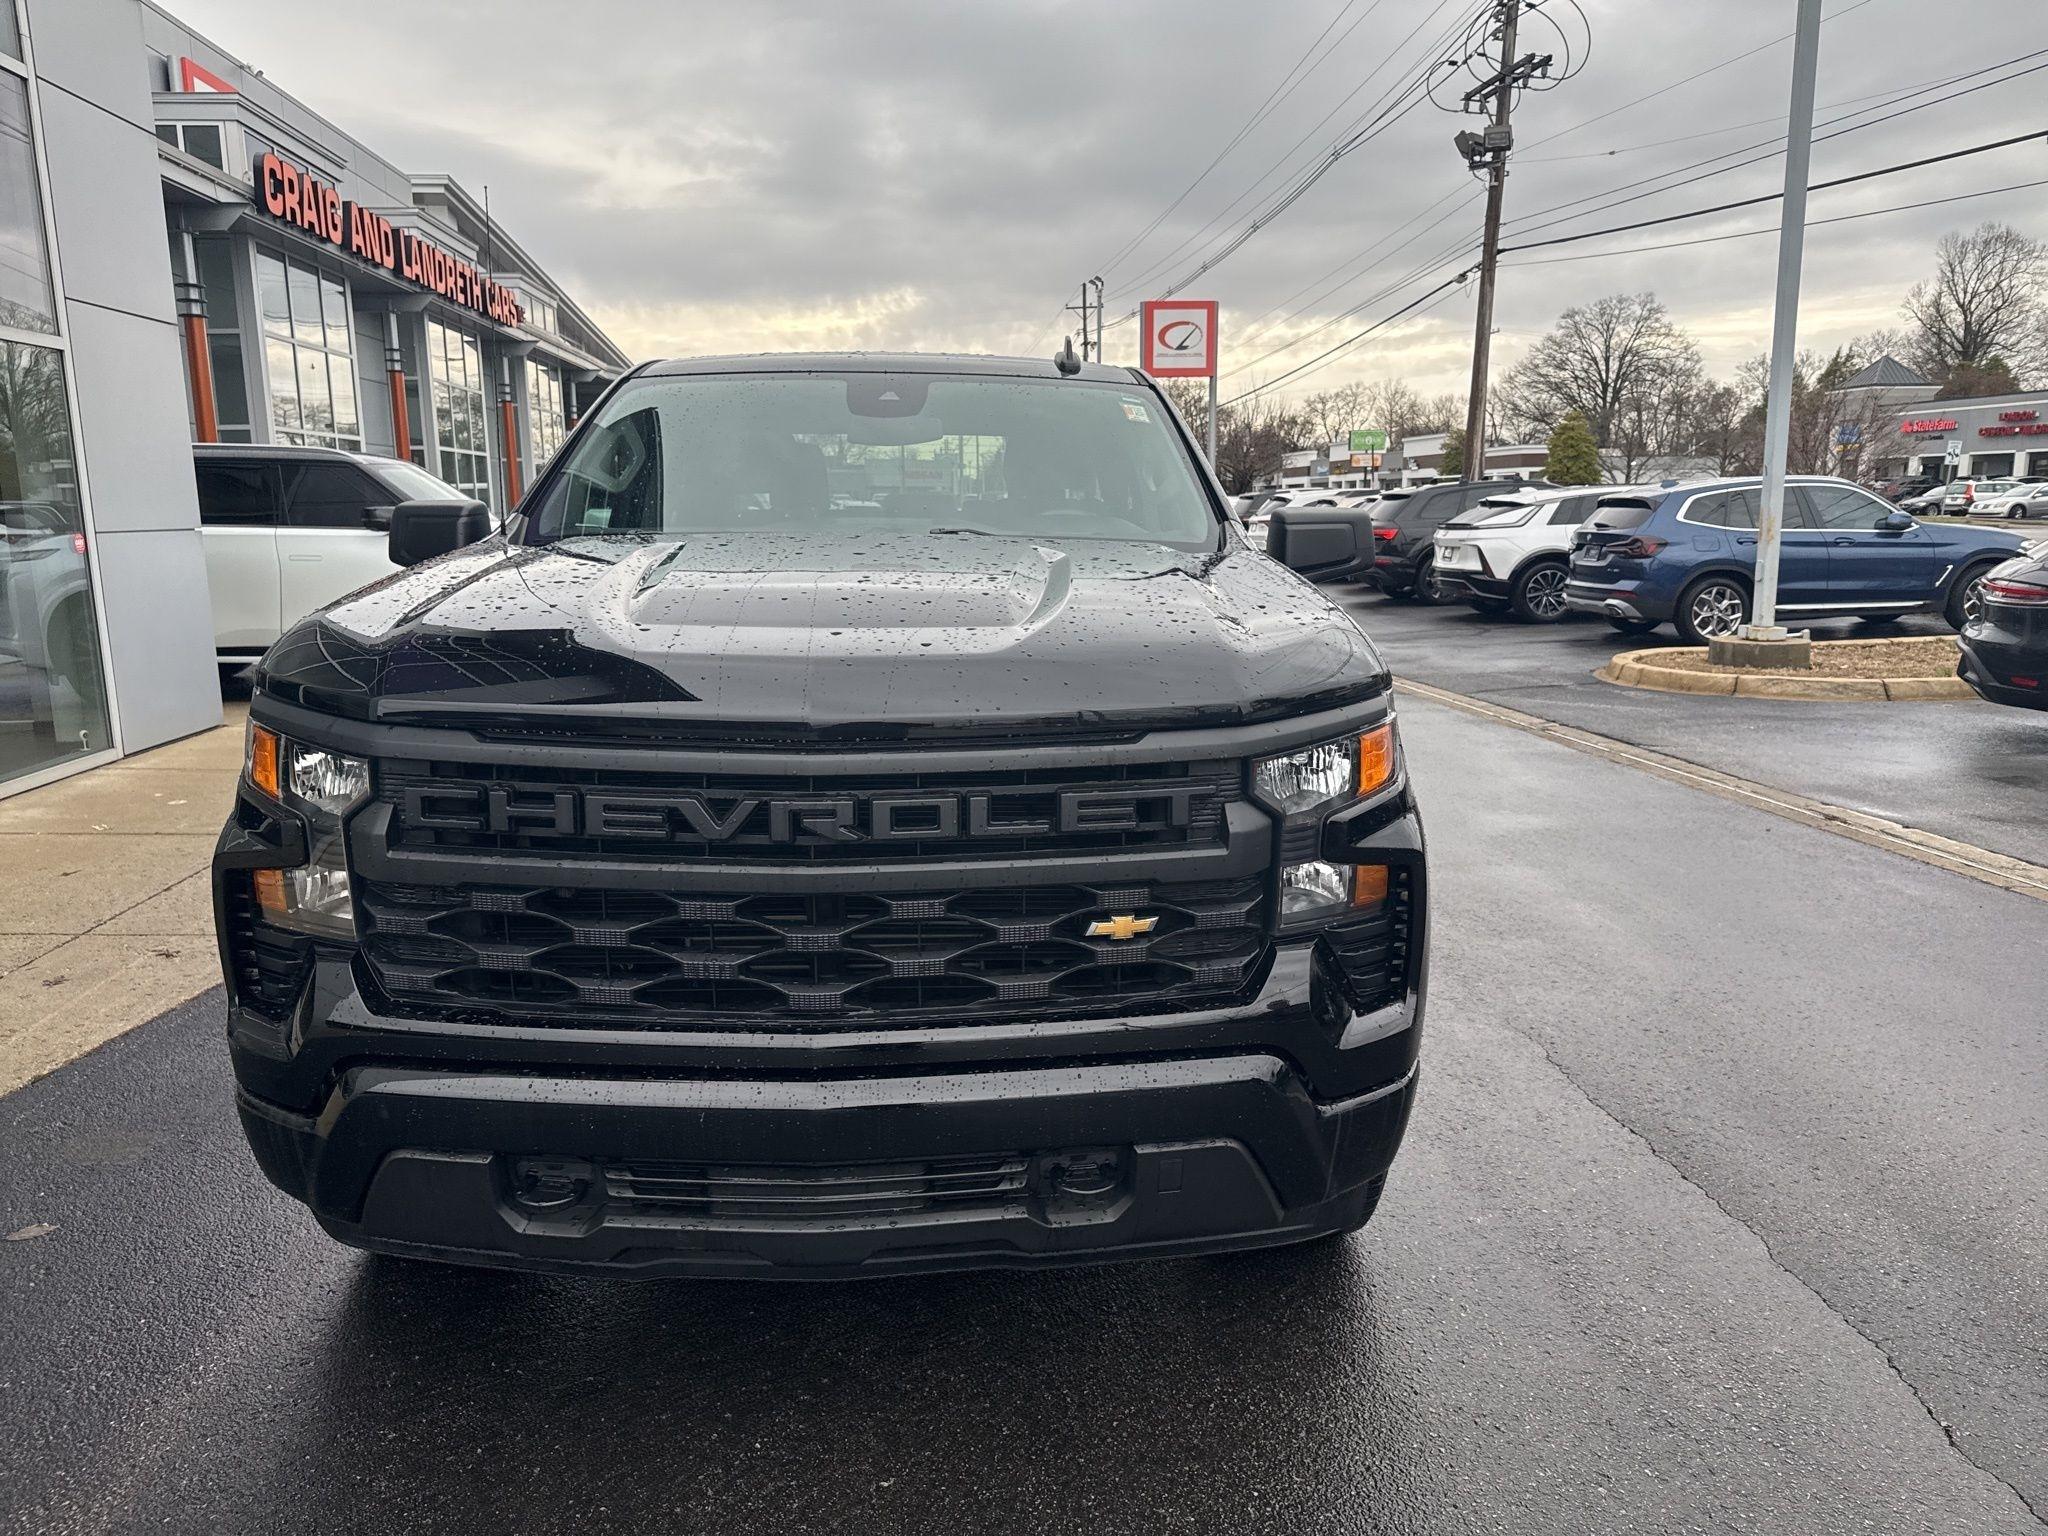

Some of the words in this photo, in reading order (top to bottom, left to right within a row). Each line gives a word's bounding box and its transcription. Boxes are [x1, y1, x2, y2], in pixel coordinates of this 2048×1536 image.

[261, 151, 343, 246] CRAIG
[350, 201, 395, 270] AND
[400, 227, 483, 313] LANDRETH
[485, 277, 518, 328] CARS
[404, 783, 1217, 841] CHEVROLET
